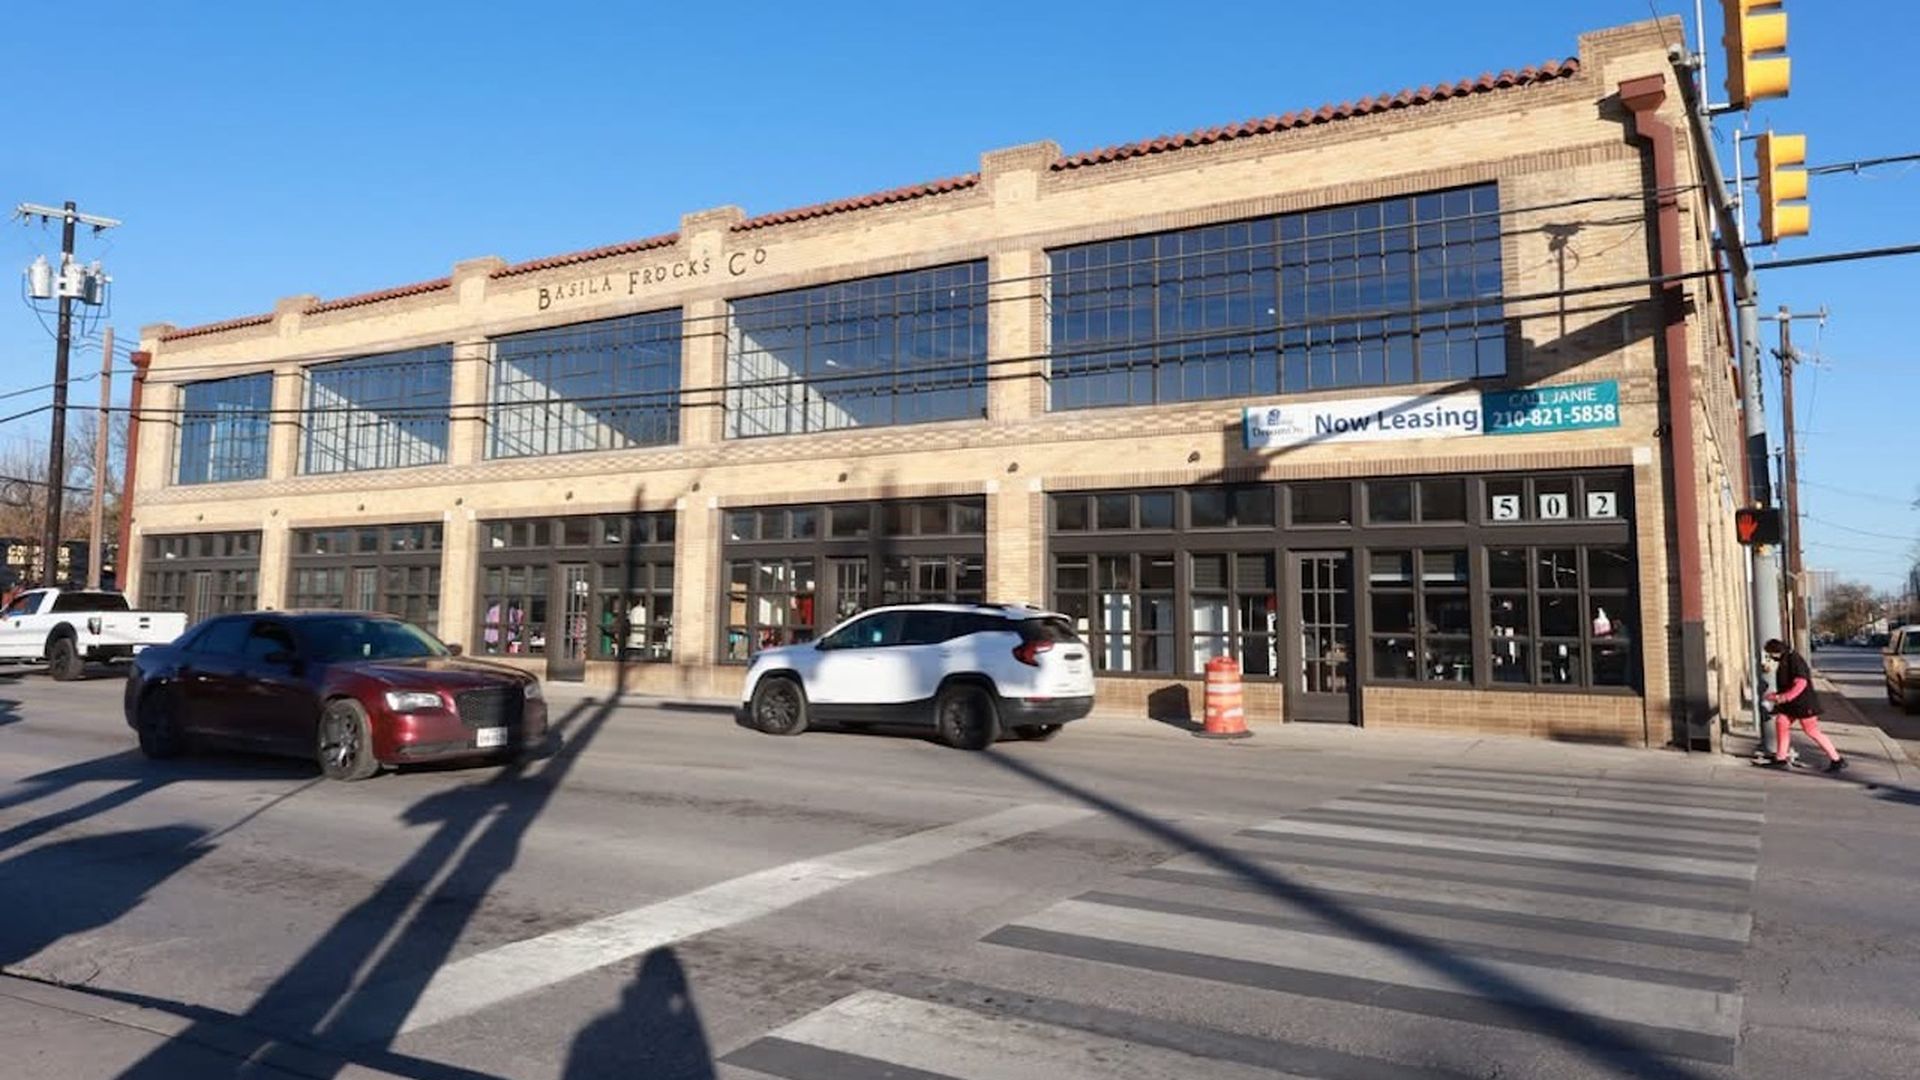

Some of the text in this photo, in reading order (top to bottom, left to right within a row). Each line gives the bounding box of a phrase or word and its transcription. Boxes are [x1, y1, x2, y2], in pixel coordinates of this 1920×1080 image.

[538, 275, 612, 310] BASILA
[627, 257, 711, 295] FROCKS
[1508, 387, 1598, 407] CALL JANIE
[1315, 412, 1370, 434] Now
[1378, 407, 1478, 431] Leasing
[1493, 404, 1616, 428] 210-821-5858
